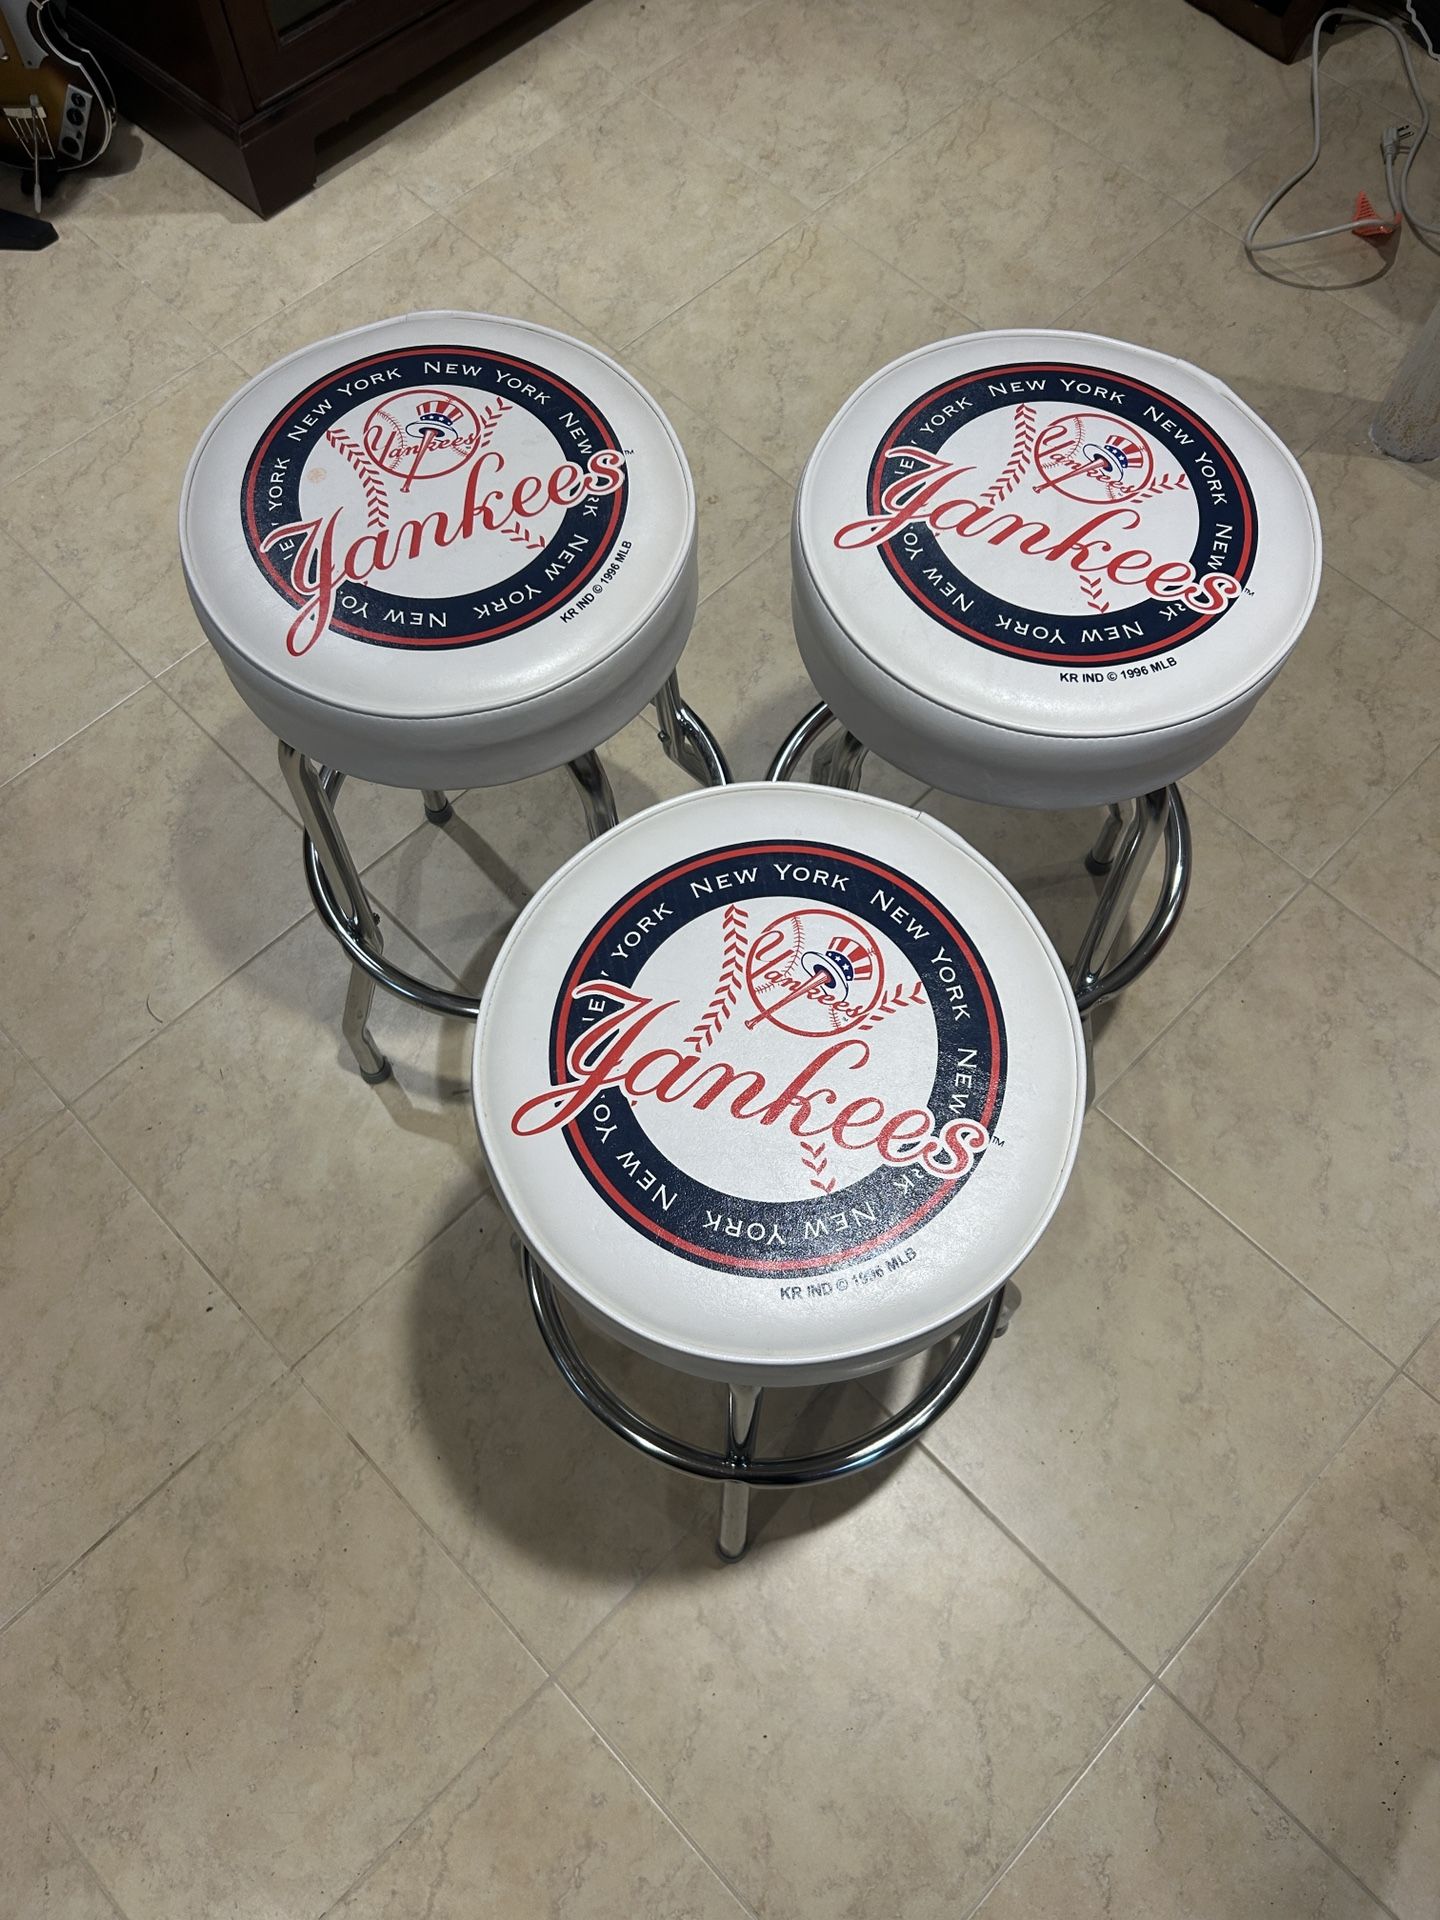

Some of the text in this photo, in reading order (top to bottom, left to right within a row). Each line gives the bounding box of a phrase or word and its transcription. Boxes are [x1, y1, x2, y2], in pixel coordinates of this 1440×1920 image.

[287, 368, 402, 442] NEW YORK
[423, 361, 552, 406] NEW YORK
[988, 379, 1127, 405] NEW YORK
[559, 411, 593, 454] NEW
[919, 396, 974, 435] YORK
[1143, 405, 1228, 506] NEW YORK
[268, 457, 291, 512] YORK
[262, 451, 625, 657] Yankees
[834, 448, 1238, 611] Yankees
[1207, 523, 1233, 570] NEW
[472, 533, 590, 620] NEW YORK
[559, 607, 579, 624] KR
[577, 592, 595, 611] IND
[600, 562, 620, 585] 1996
[618, 540, 632, 563] MLB
[922, 567, 974, 612] NEW
[384, 609, 447, 629] NEW
[995, 614, 1144, 645] NEW YORK
[1059, 672, 1079, 683] KR
[1082, 673, 1104, 683] IND
[1121, 665, 1149, 680] 1996
[1150, 656, 1178, 673] MLB
[690, 863, 850, 899] NEW YORK
[611, 903, 674, 959] YORK
[870, 889, 971, 1022] NEW YORK
[511, 983, 986, 1175] Yankees
[948, 1047, 978, 1115] NEW
[616, 1151, 678, 1211] NEW
[702, 1201, 877, 1245] NEW YORK
[780, 1286, 803, 1300] KR
[807, 1282, 833, 1298] IND
[887, 1247, 918, 1272] MLB
